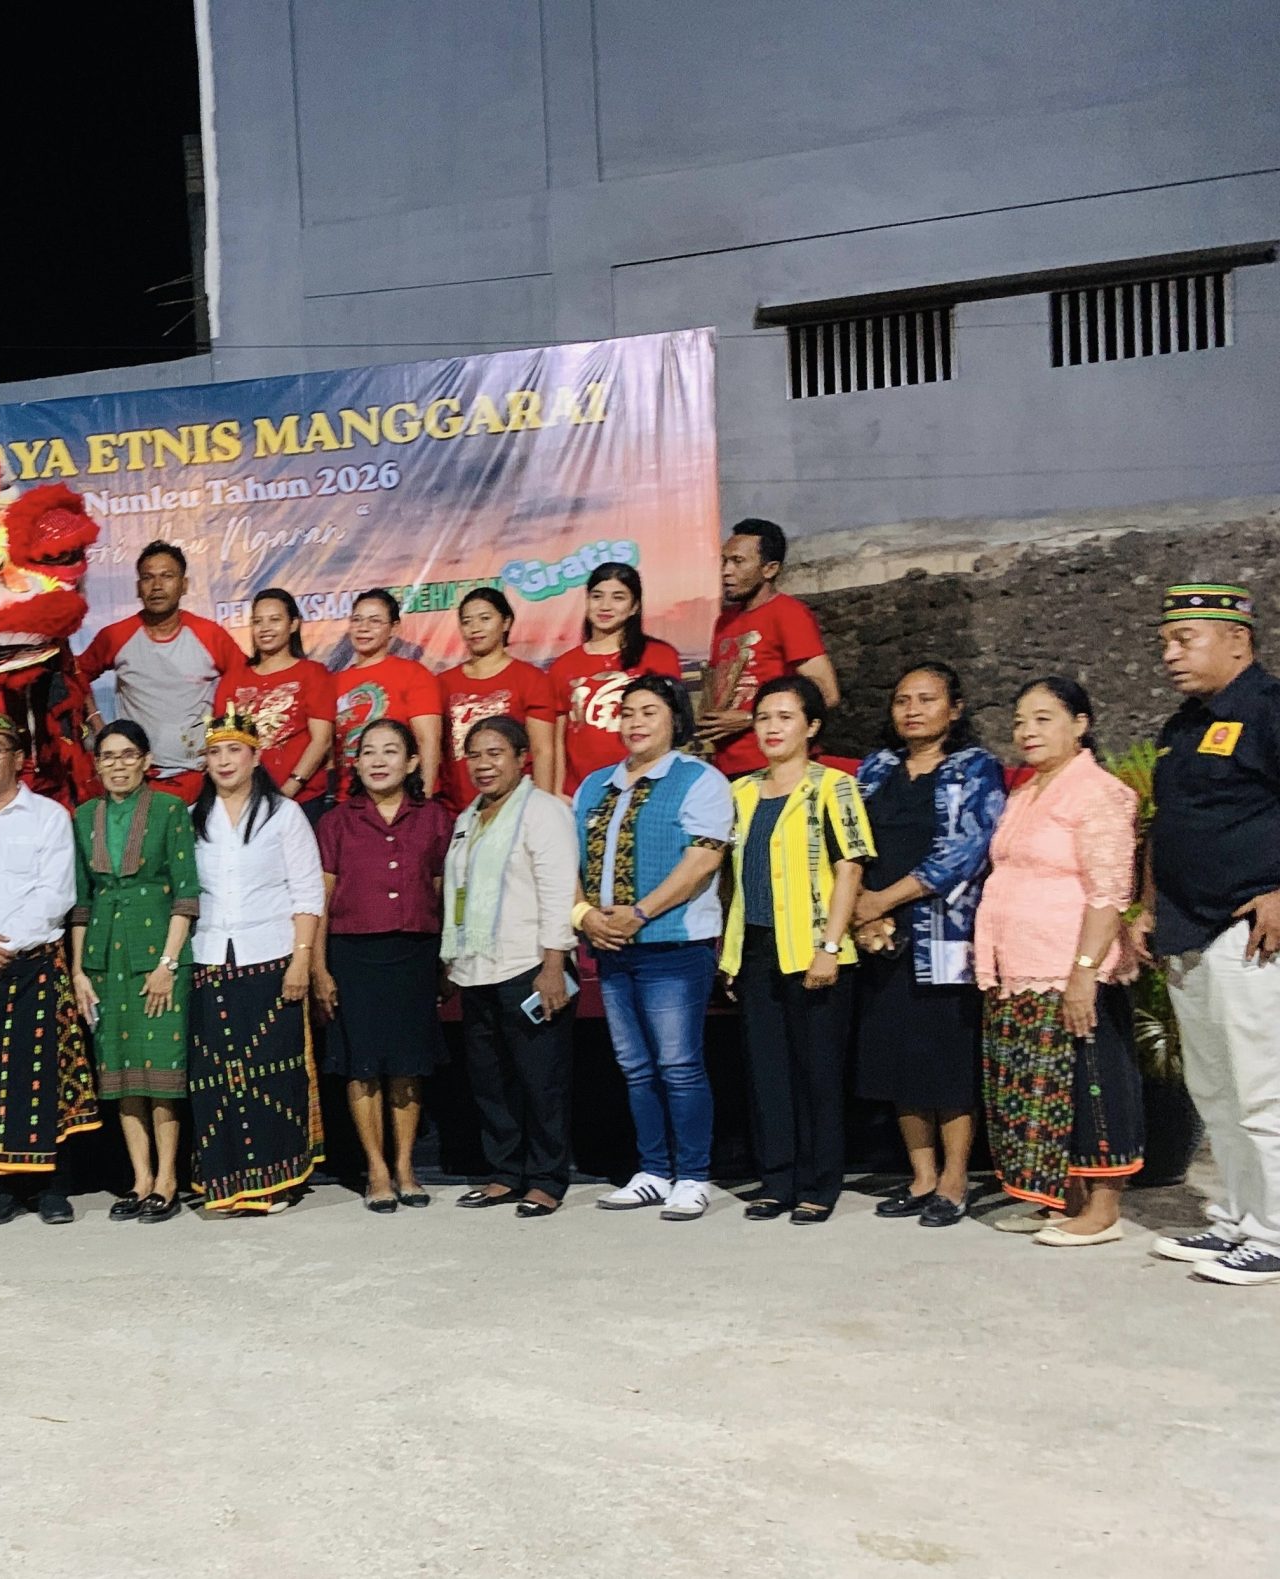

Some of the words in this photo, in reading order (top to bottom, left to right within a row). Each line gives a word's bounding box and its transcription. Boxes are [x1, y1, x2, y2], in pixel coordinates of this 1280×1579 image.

[86, 419, 243, 474] ETNIS
[253, 380, 607, 459] MANGGARAI
[83, 484, 201, 516] Nunleu
[205, 475, 311, 506] Tahun
[316, 461, 400, 496] 2026
[520, 540, 635, 593] Gratis
